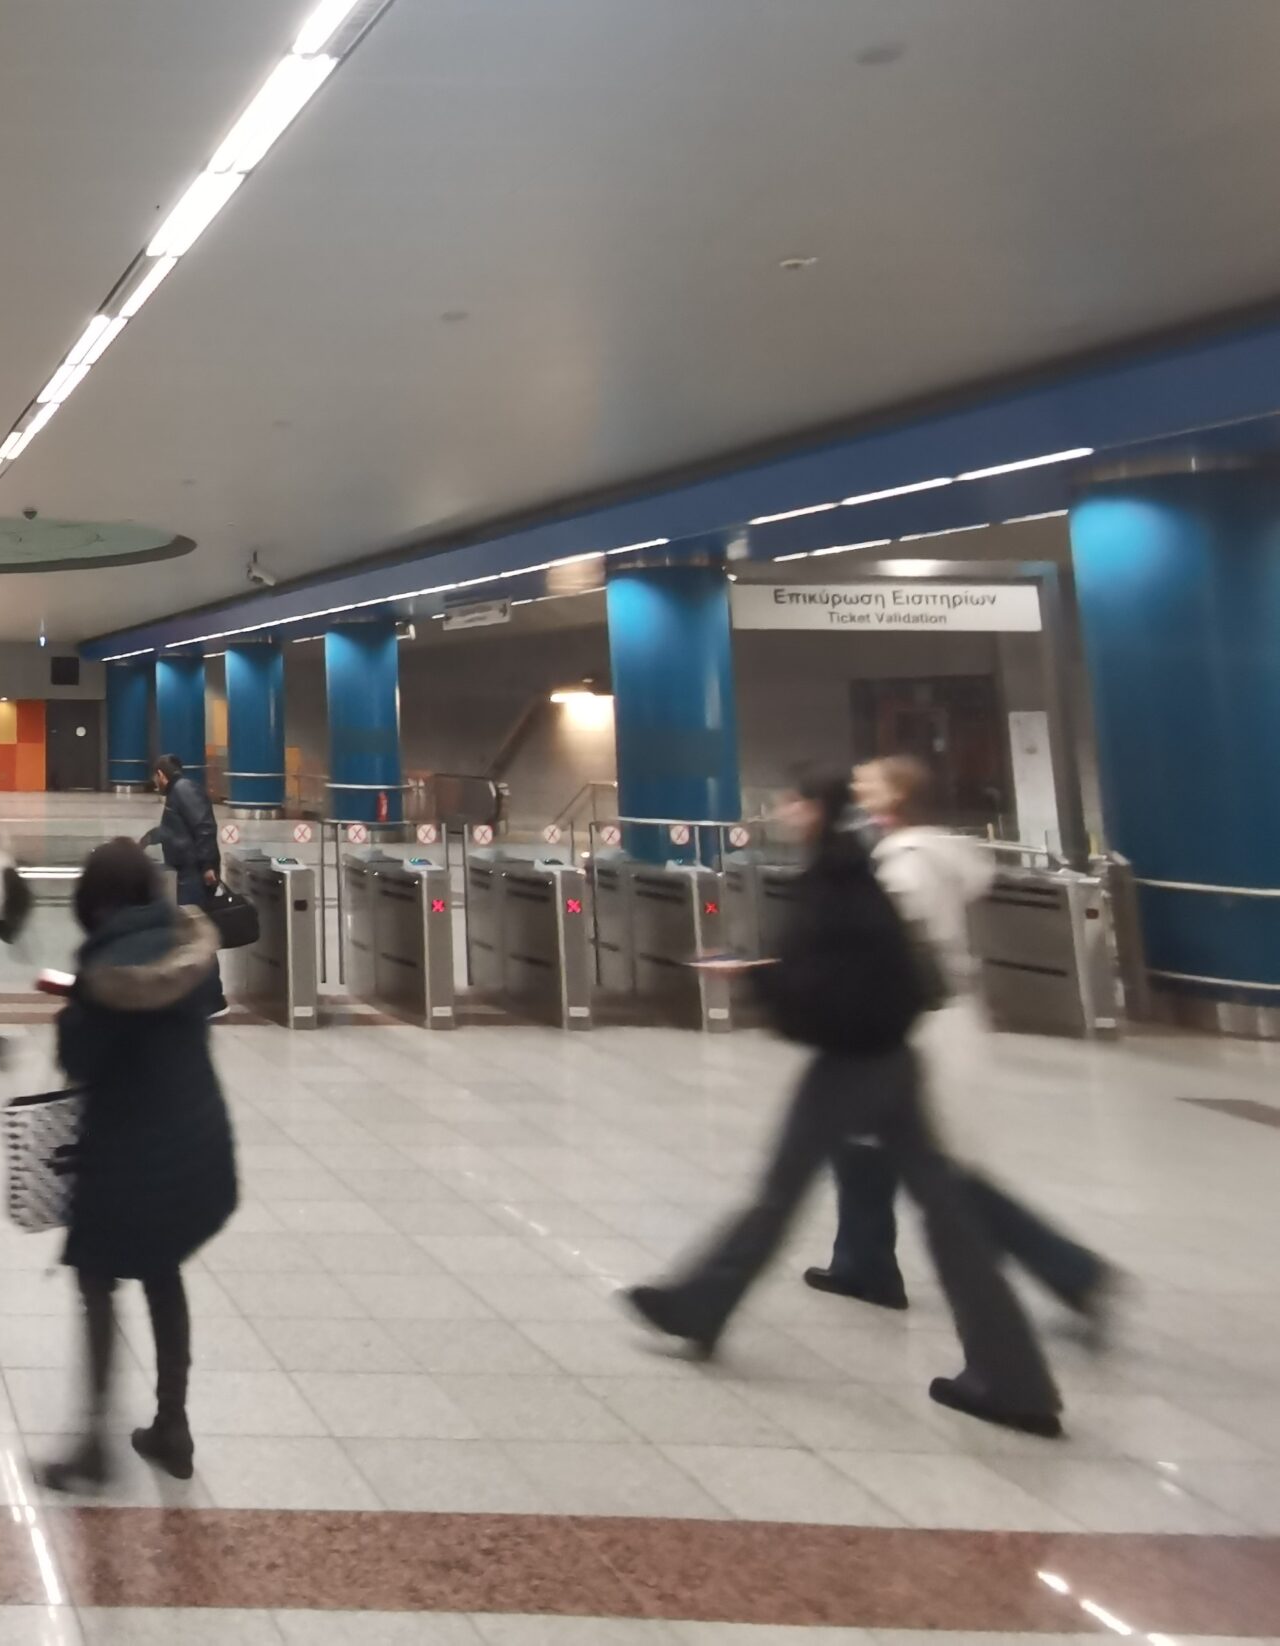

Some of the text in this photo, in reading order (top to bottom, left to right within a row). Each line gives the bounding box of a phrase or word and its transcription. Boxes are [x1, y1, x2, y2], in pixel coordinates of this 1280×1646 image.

[773, 588, 997, 609] Επικύρωση Εισιτηρίων
[828, 611, 947, 625] Ticket Validation
